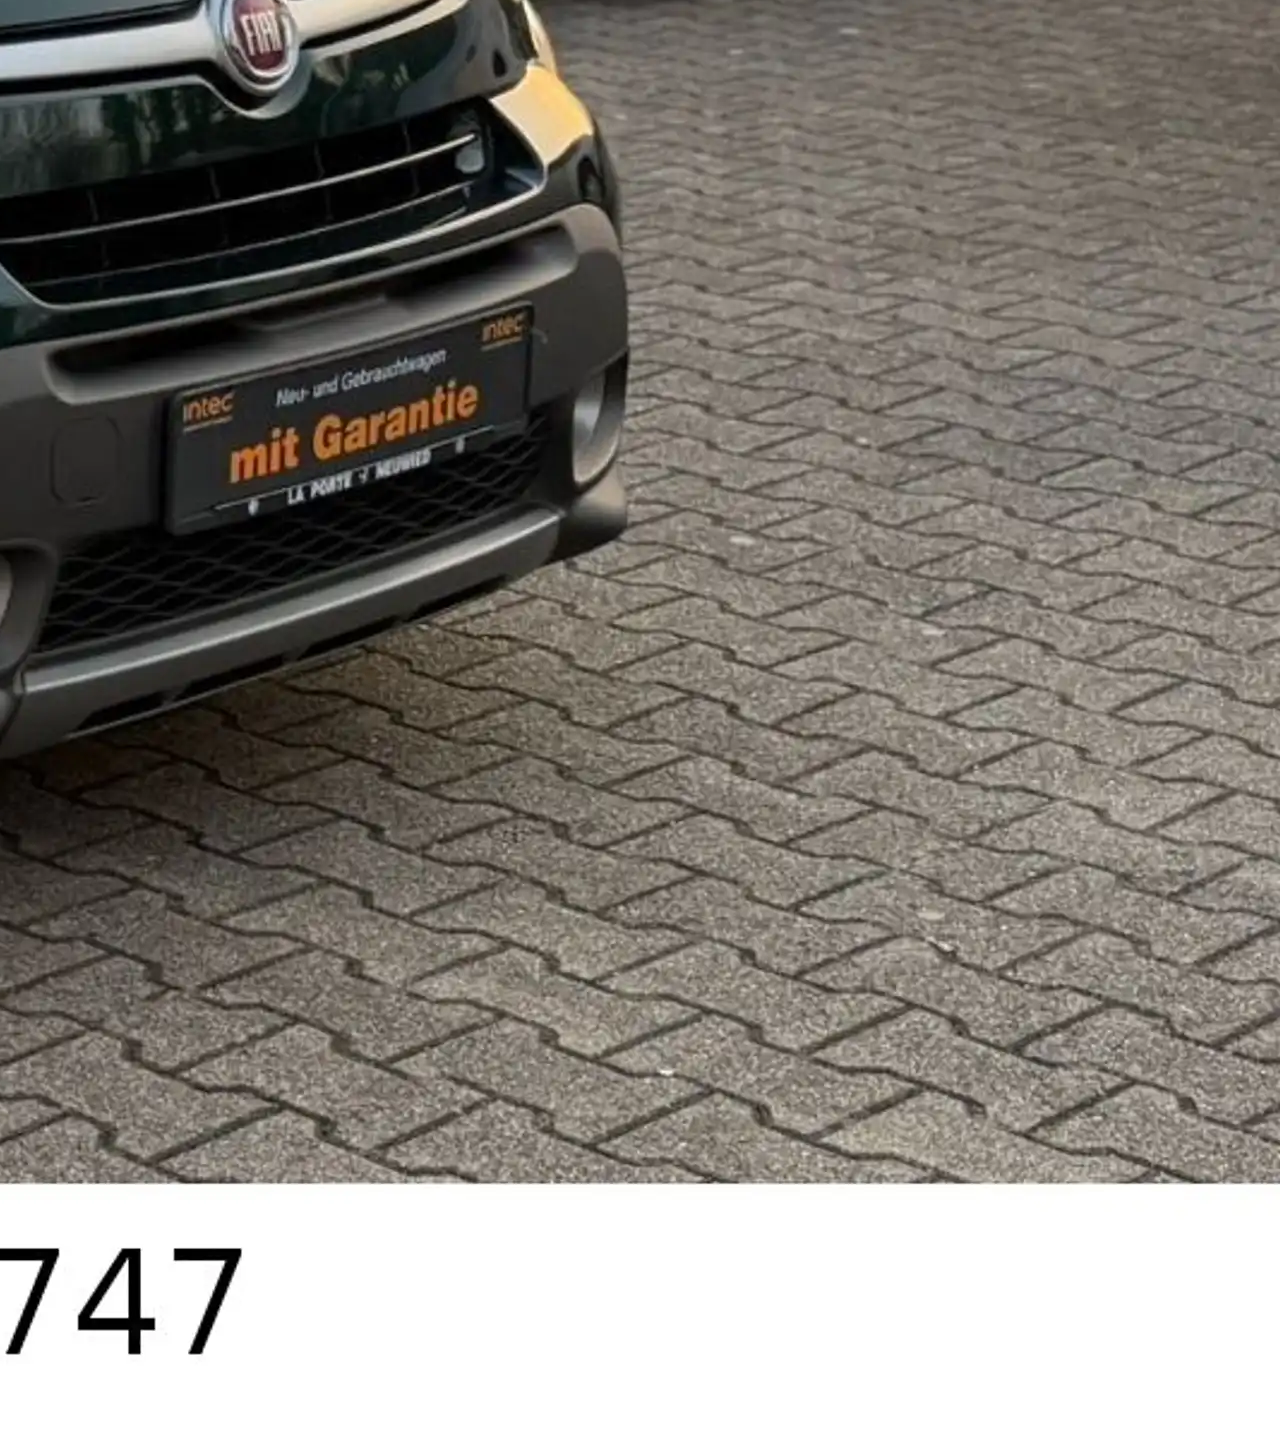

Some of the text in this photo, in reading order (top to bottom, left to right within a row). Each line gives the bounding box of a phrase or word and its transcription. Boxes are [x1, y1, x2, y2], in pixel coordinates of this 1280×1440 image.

[240, 10, 283, 56] FIAT
[182, 389, 236, 423] intec
[274, 347, 448, 408] Neu- und Gebrauchtwagen
[228, 377, 479, 484] mit Garantie
[286, 447, 432, 506] LA PORTE NEUWIED
